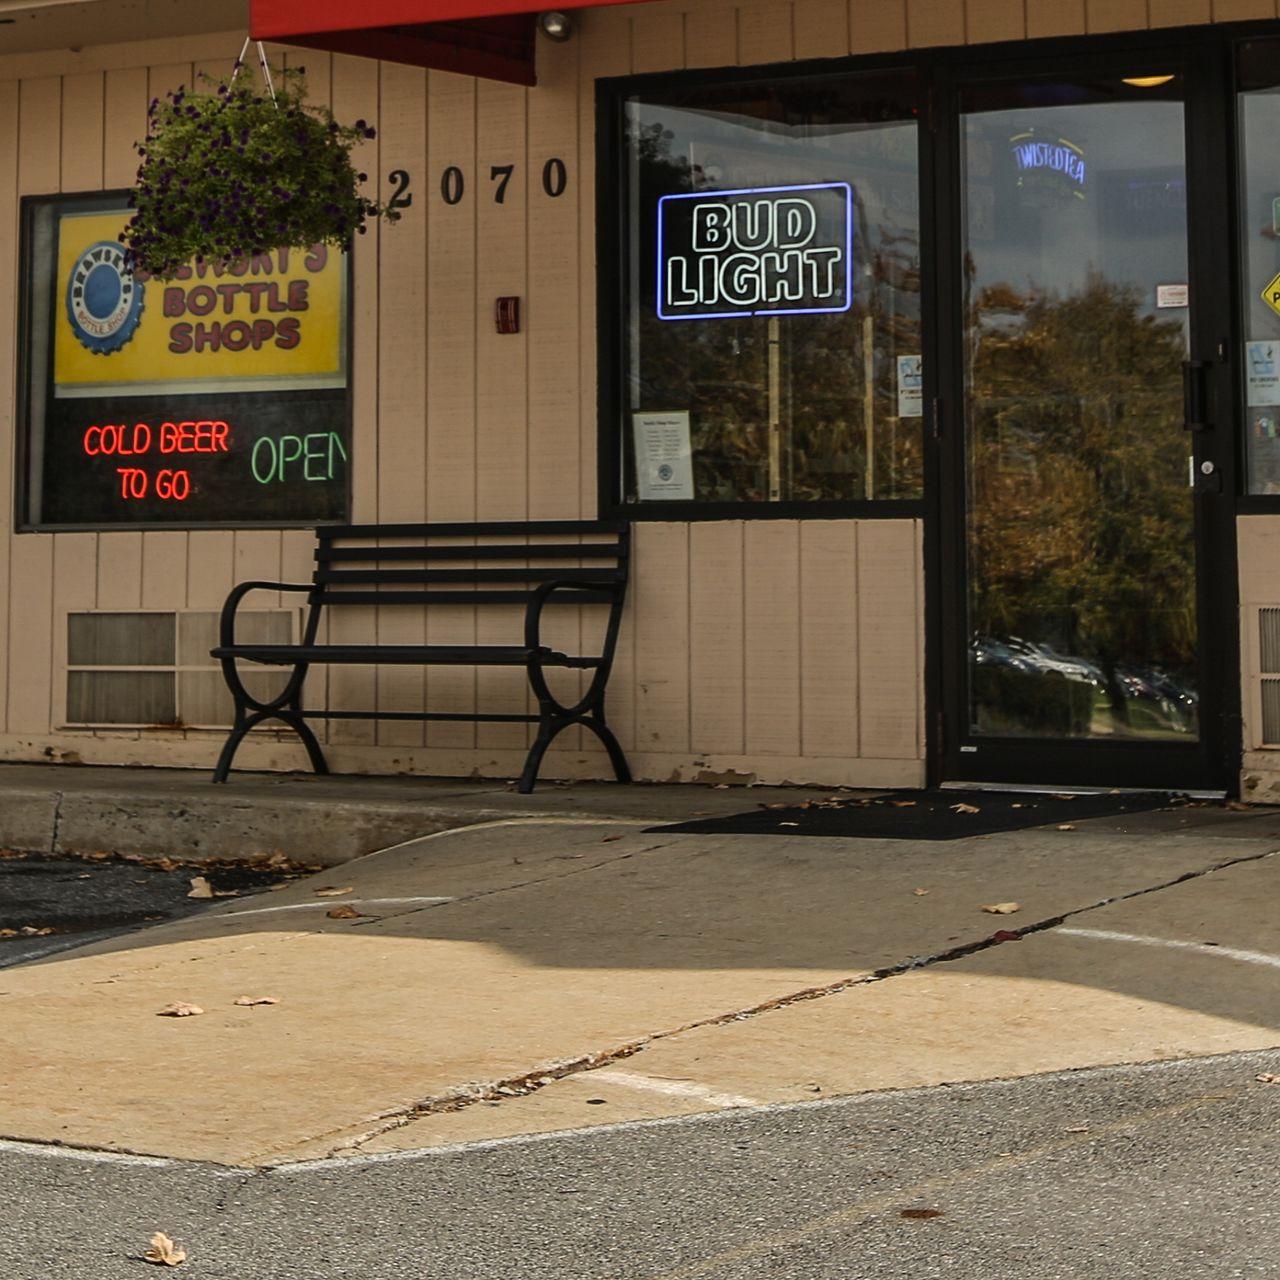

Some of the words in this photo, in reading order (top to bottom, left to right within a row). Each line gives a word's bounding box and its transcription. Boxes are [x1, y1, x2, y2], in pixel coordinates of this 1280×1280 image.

[388, 158, 568, 209] 2070
[692, 198, 817, 252] BUD
[667, 246, 842, 306] LIGHT
[164, 279, 310, 318] BOTTLE
[168, 317, 301, 355] SHOPS
[83, 422, 151, 456] COLD
[160, 420, 229, 454] BEER
[116, 468, 148, 499] TO
[155, 469, 190, 500] GO
